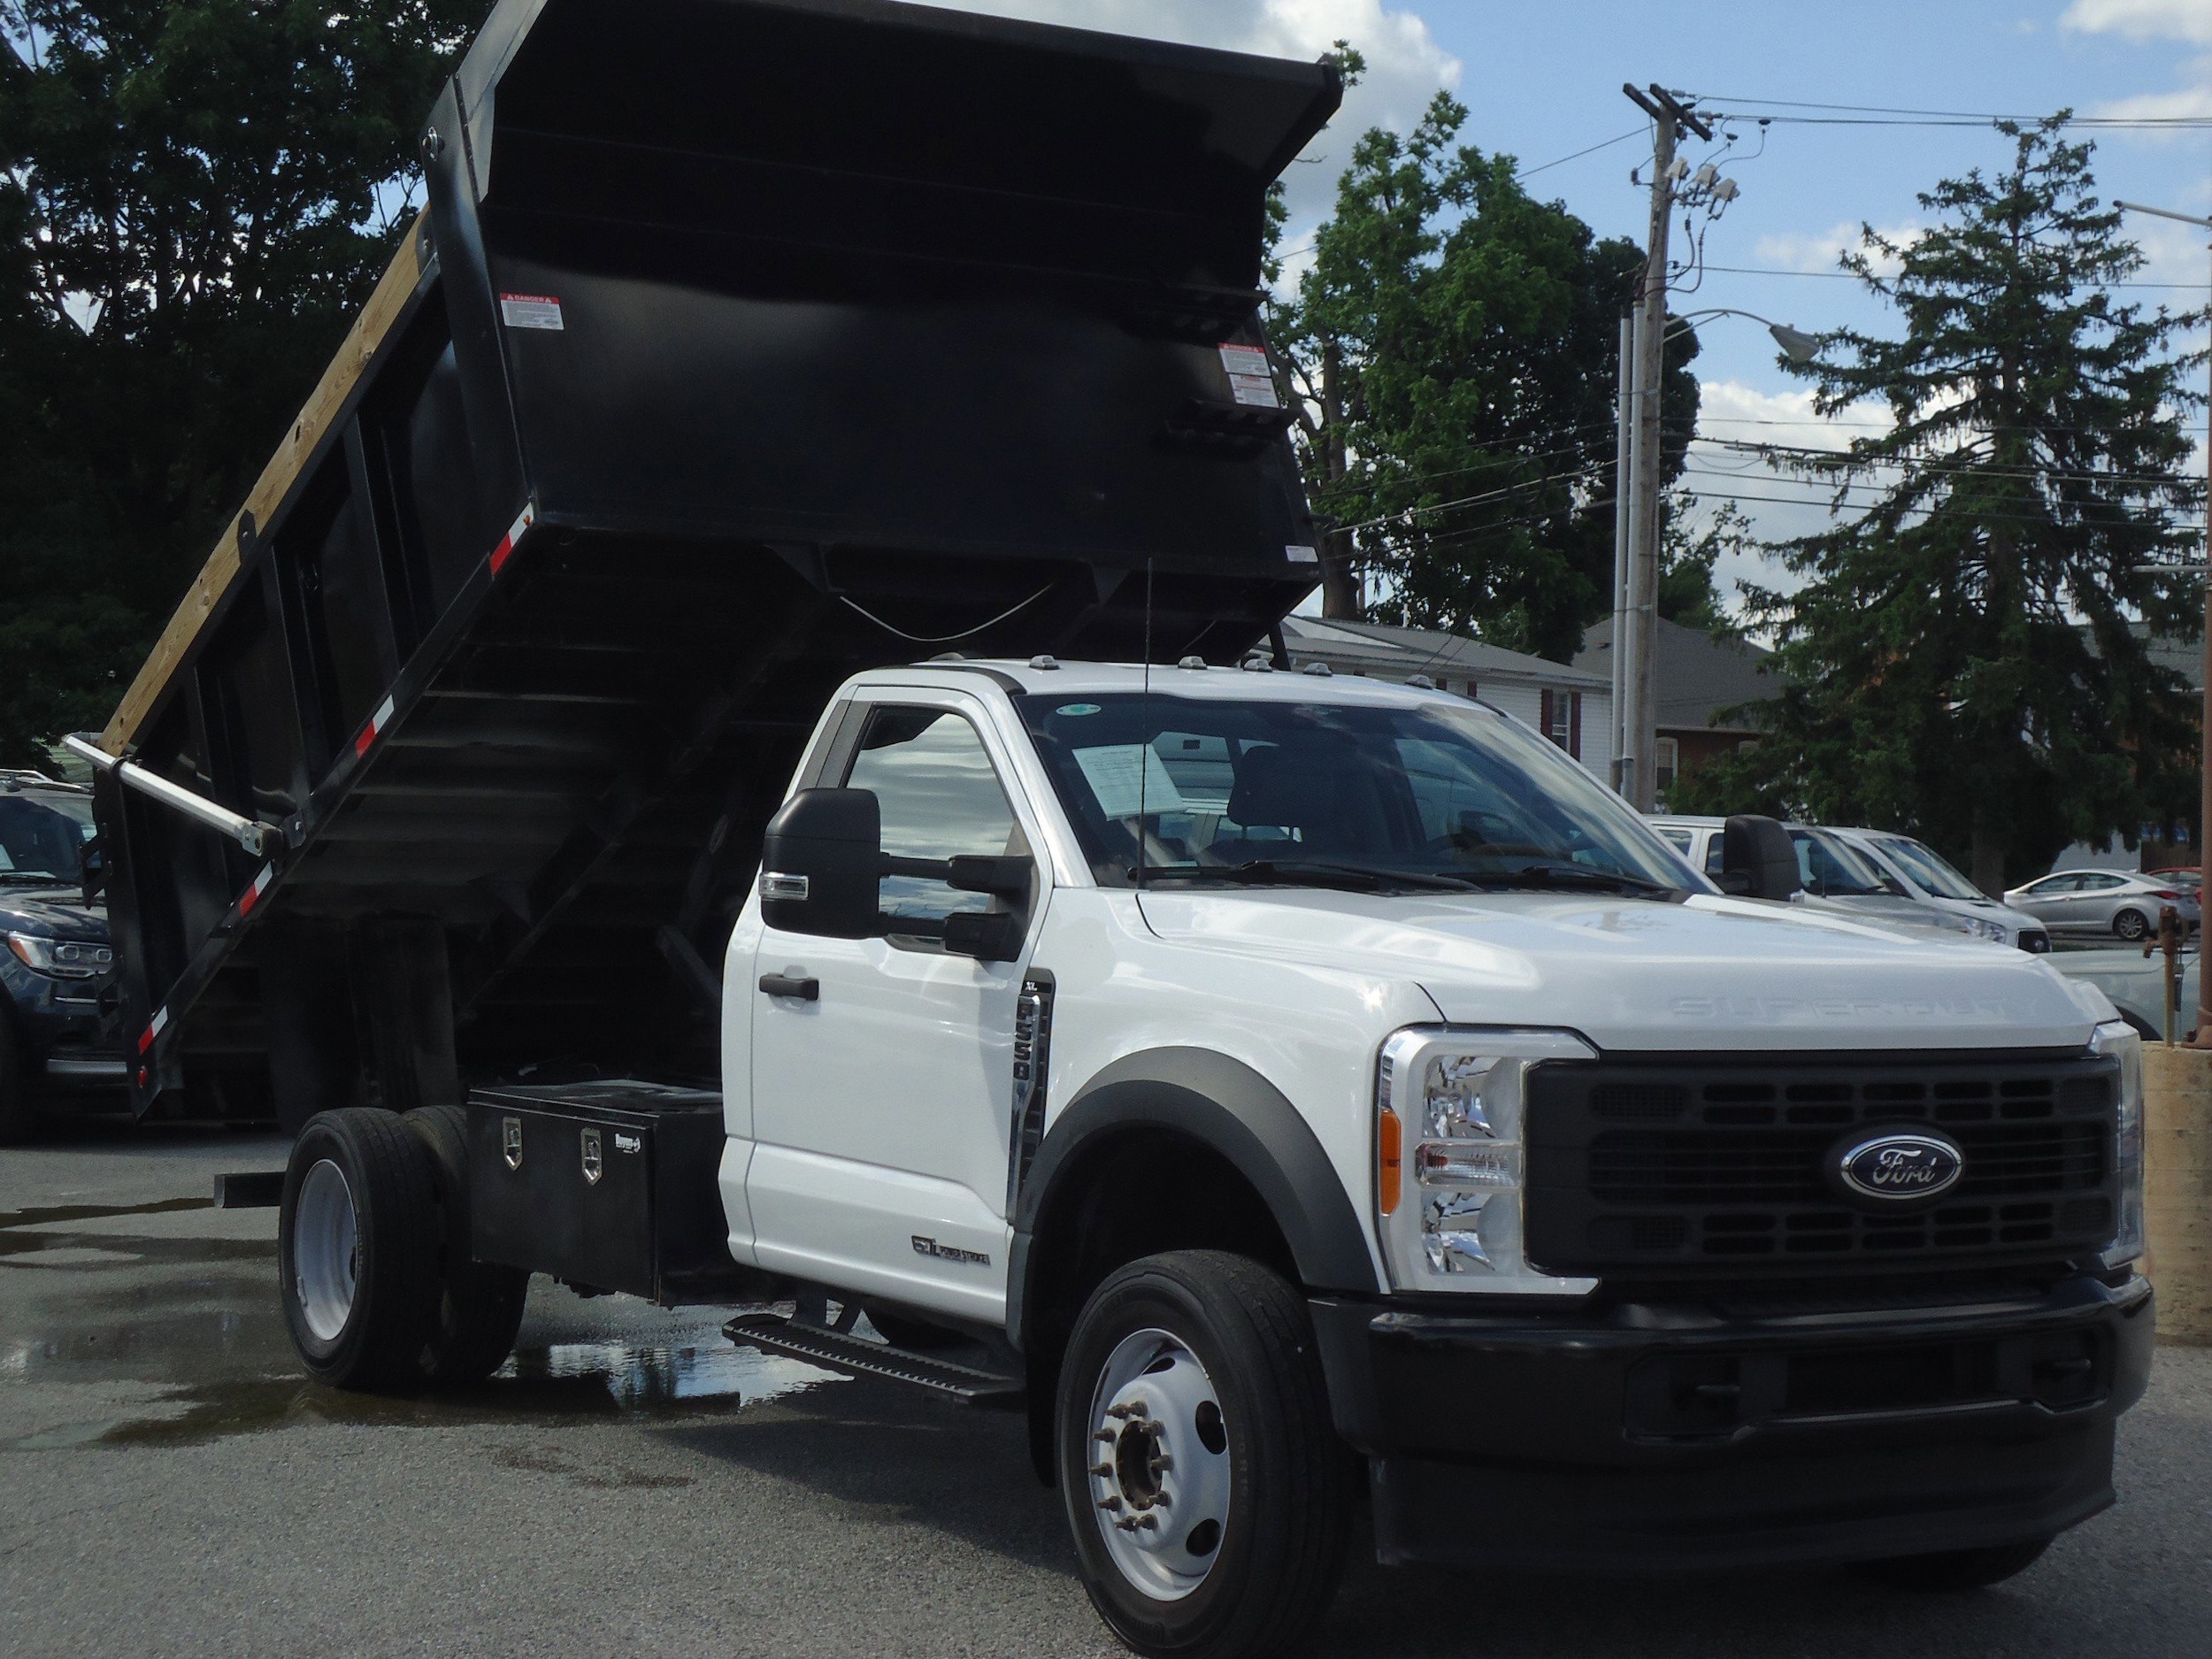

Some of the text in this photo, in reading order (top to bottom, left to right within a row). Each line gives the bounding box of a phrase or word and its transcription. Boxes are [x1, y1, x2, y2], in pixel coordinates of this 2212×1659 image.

[1025, 980, 1038, 992] XL
[1670, 996, 1893, 1018] SUPER
[1872, 1148, 1937, 1185] Ford
[960, 1249, 989, 1265] STROKE
